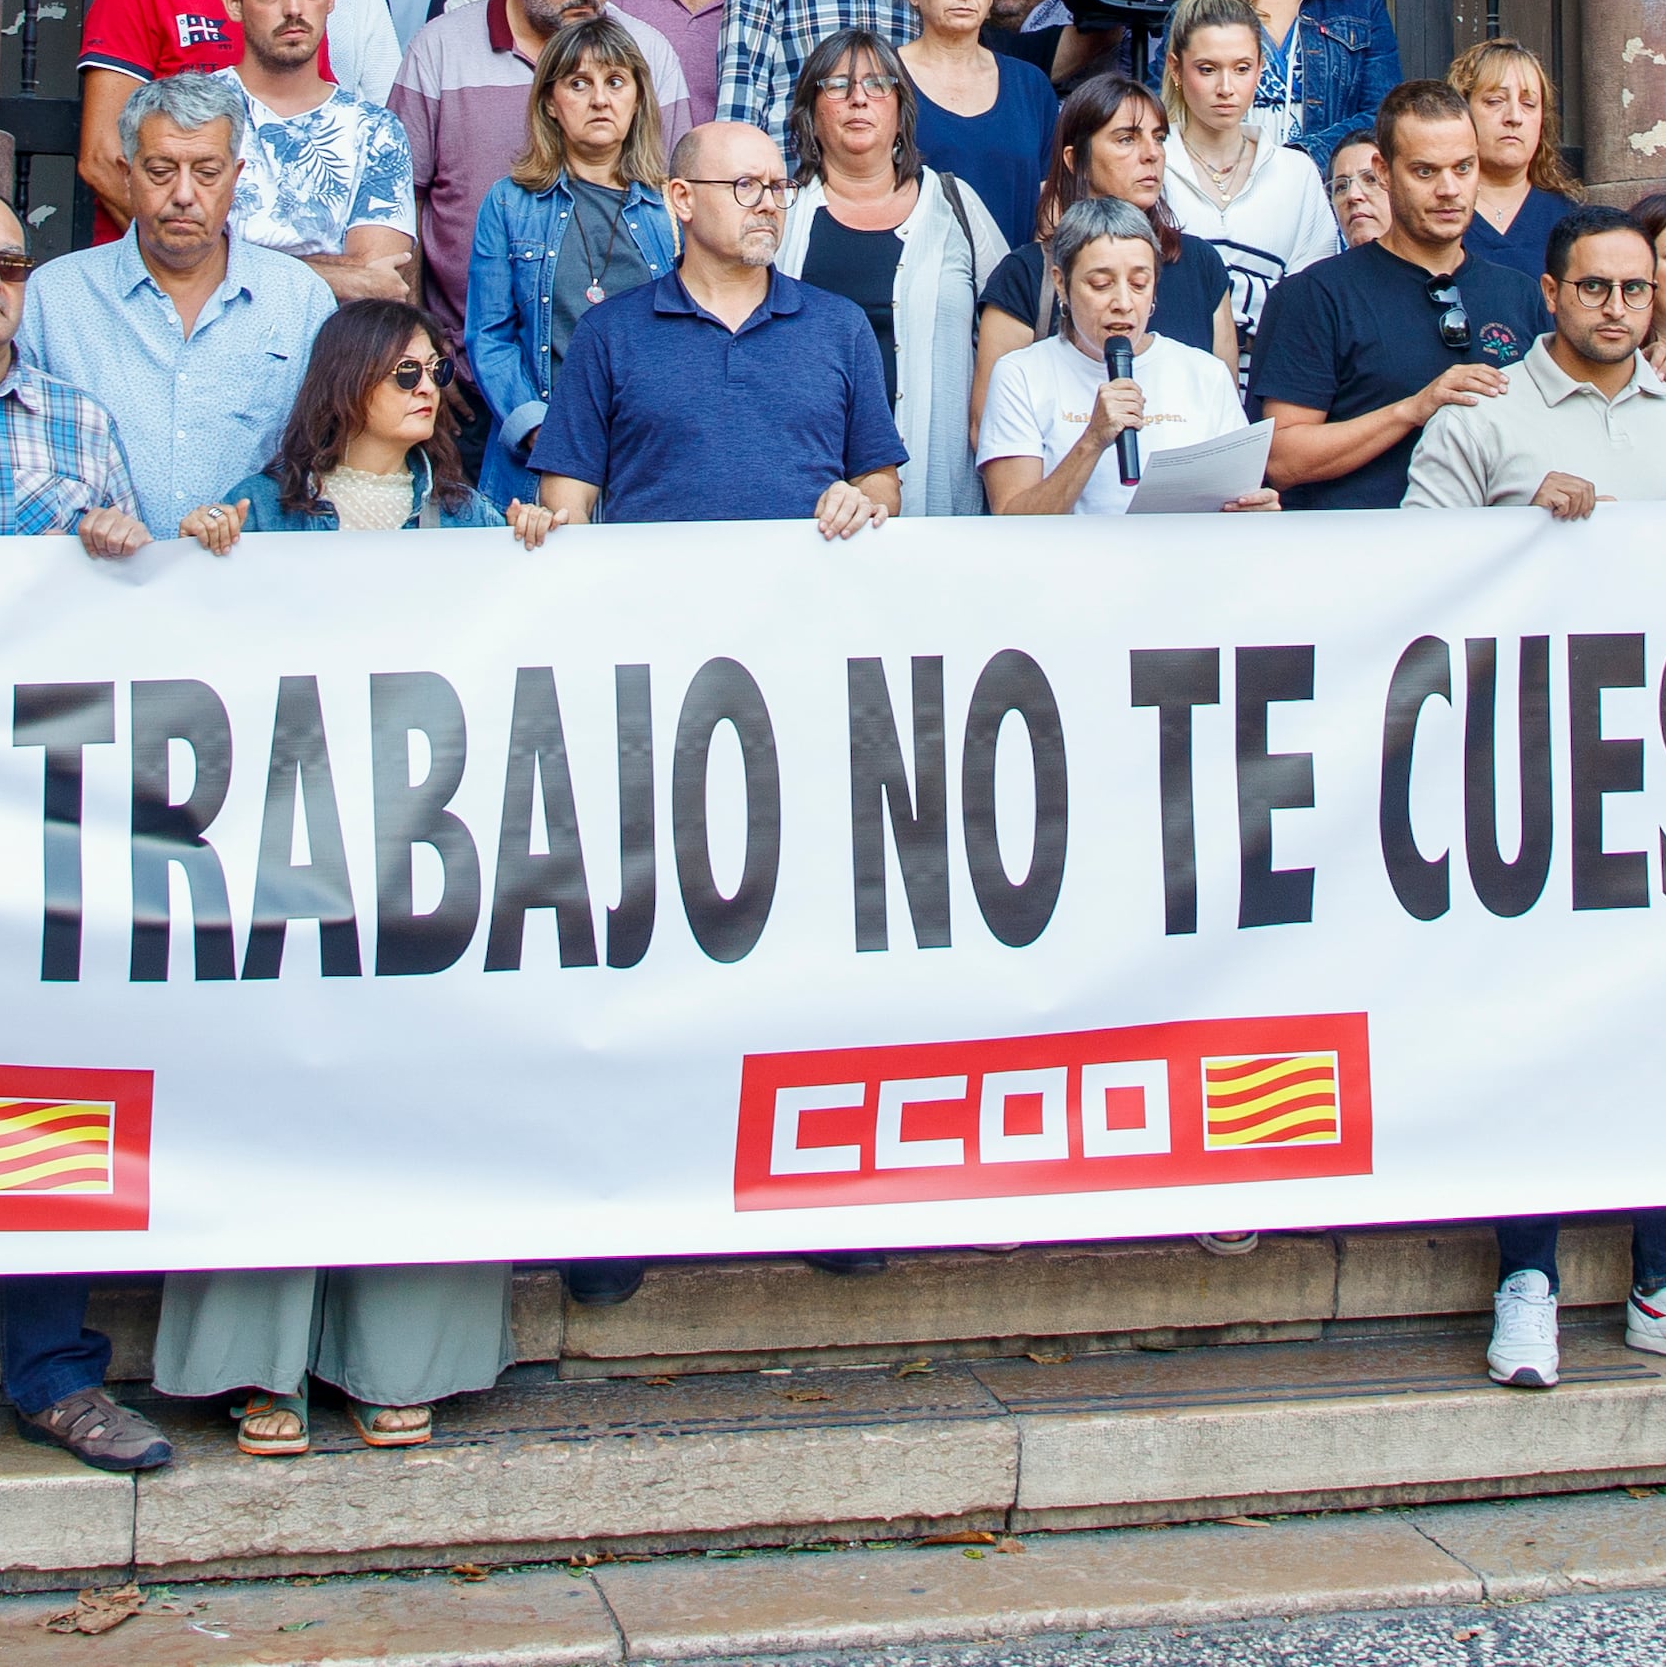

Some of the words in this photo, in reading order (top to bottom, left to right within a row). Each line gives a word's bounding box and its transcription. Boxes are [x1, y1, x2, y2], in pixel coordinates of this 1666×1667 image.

[1062, 410, 1092, 423] Mak
[13, 655, 780, 983] TRABAJO
[847, 648, 1068, 953] NO
[1130, 645, 1316, 936] TE
[770, 1058, 1172, 1176] CCOO
